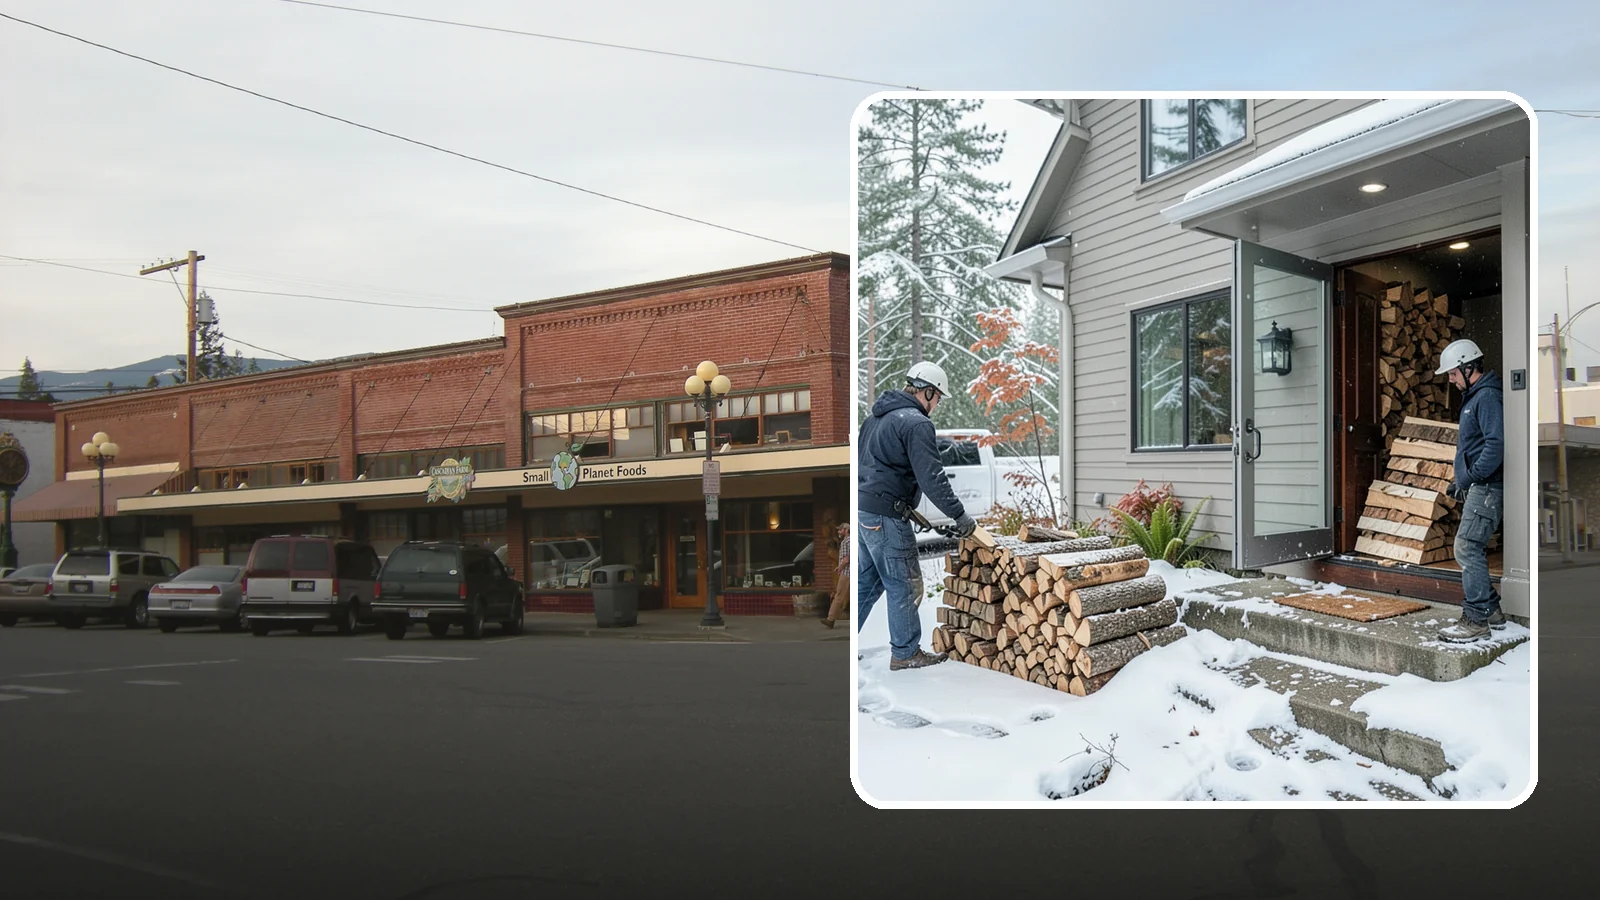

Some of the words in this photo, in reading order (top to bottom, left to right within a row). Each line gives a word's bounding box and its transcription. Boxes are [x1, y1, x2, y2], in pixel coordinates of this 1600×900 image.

[523, 470, 549, 483] Small
[582, 467, 614, 479] Planet
[617, 464, 647, 477] Foods
